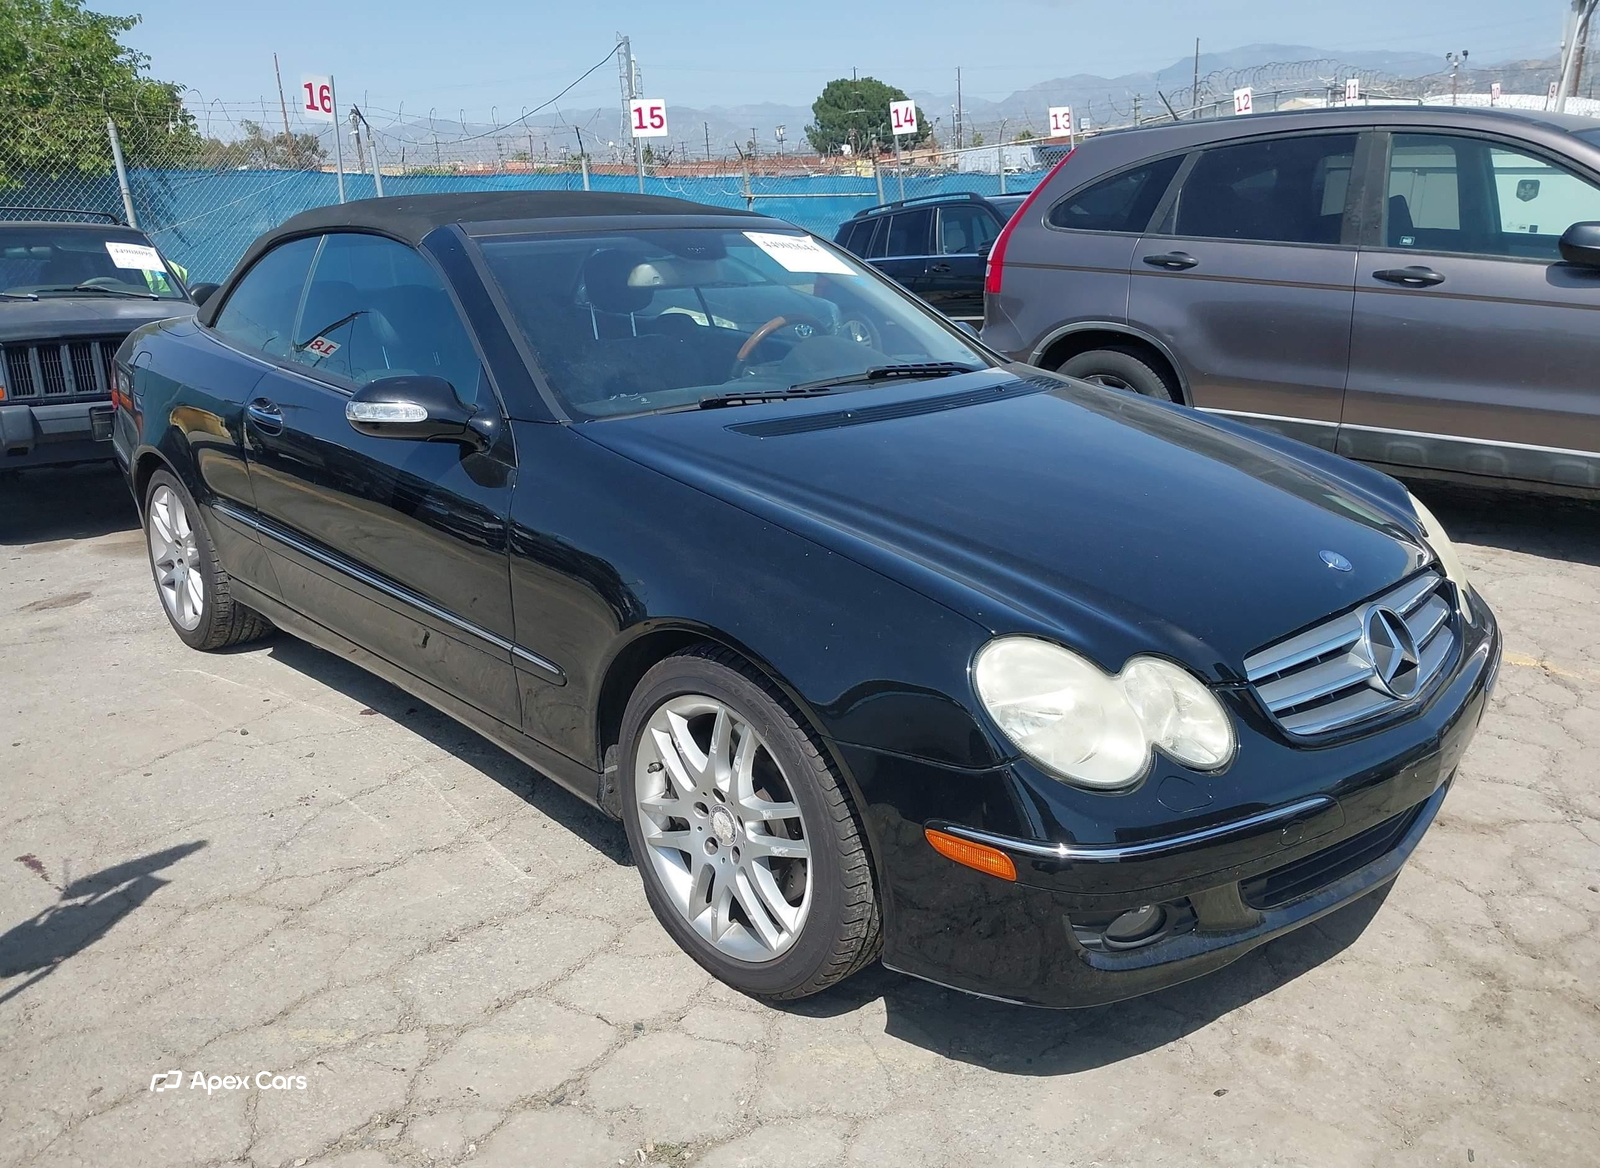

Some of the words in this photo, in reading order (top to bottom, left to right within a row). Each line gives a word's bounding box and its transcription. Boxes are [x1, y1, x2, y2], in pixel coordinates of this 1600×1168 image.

[303, 82, 332, 114] 16
[1347, 84, 1357, 99] 11
[1236, 93, 1251, 112] 12
[633, 106, 665, 130] 15
[892, 106, 915, 129] 14
[1051, 112, 1071, 130] 13
